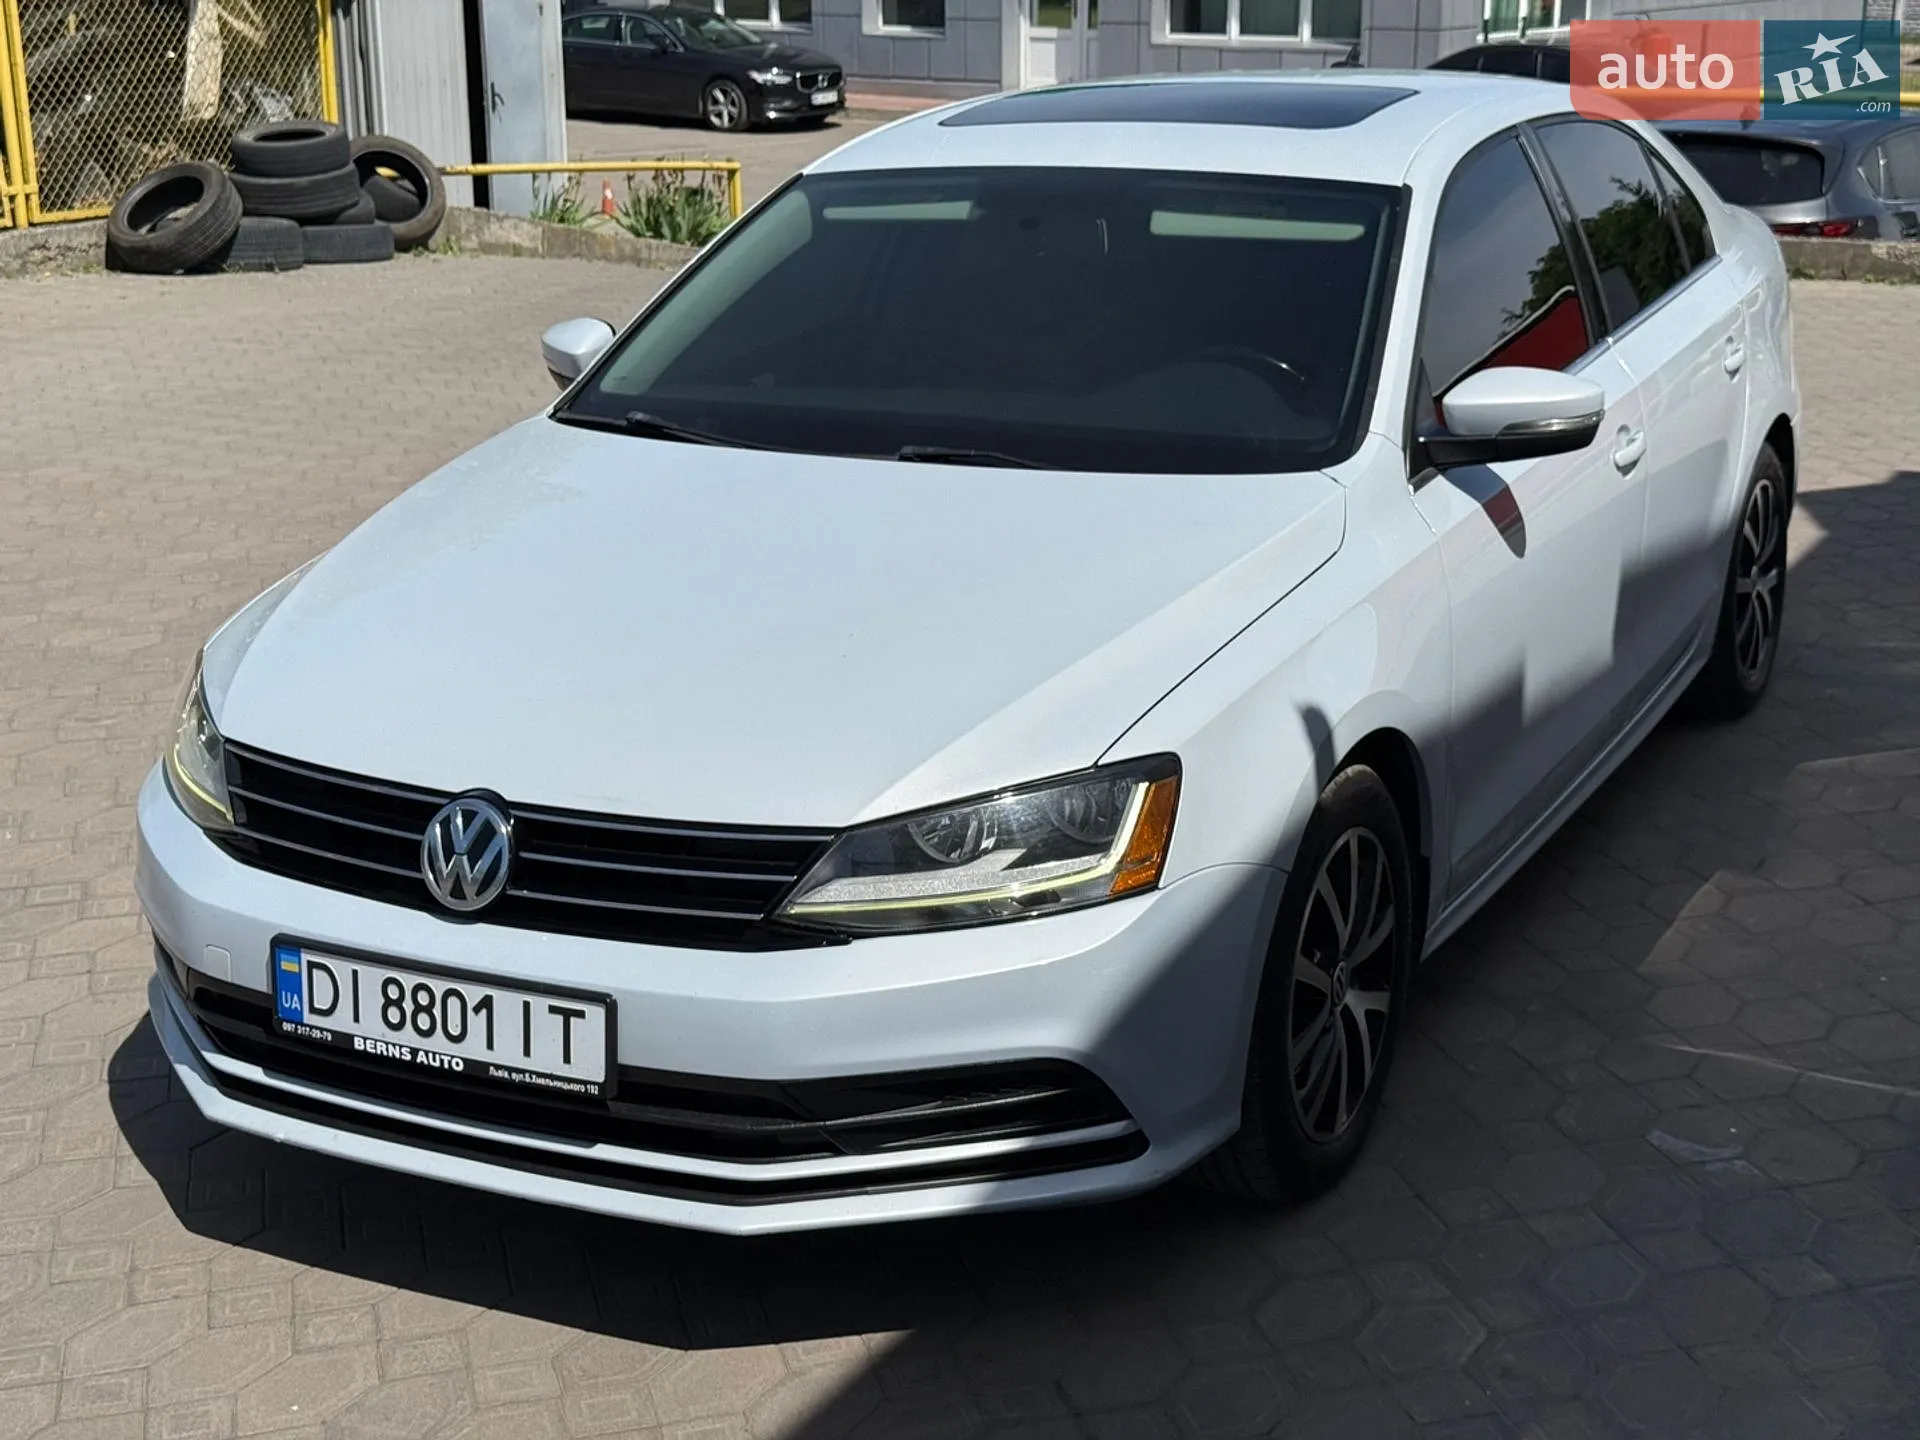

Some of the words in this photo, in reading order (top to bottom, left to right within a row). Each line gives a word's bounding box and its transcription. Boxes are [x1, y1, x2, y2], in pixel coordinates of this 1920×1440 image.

[282, 991, 300, 1011] UA
[306, 959, 360, 1024] DI
[381, 976, 494, 1051] 8801
[522, 1000, 587, 1065] IT
[353, 1036, 412, 1061] BERNS
[416, 1051, 465, 1073] AUTO
